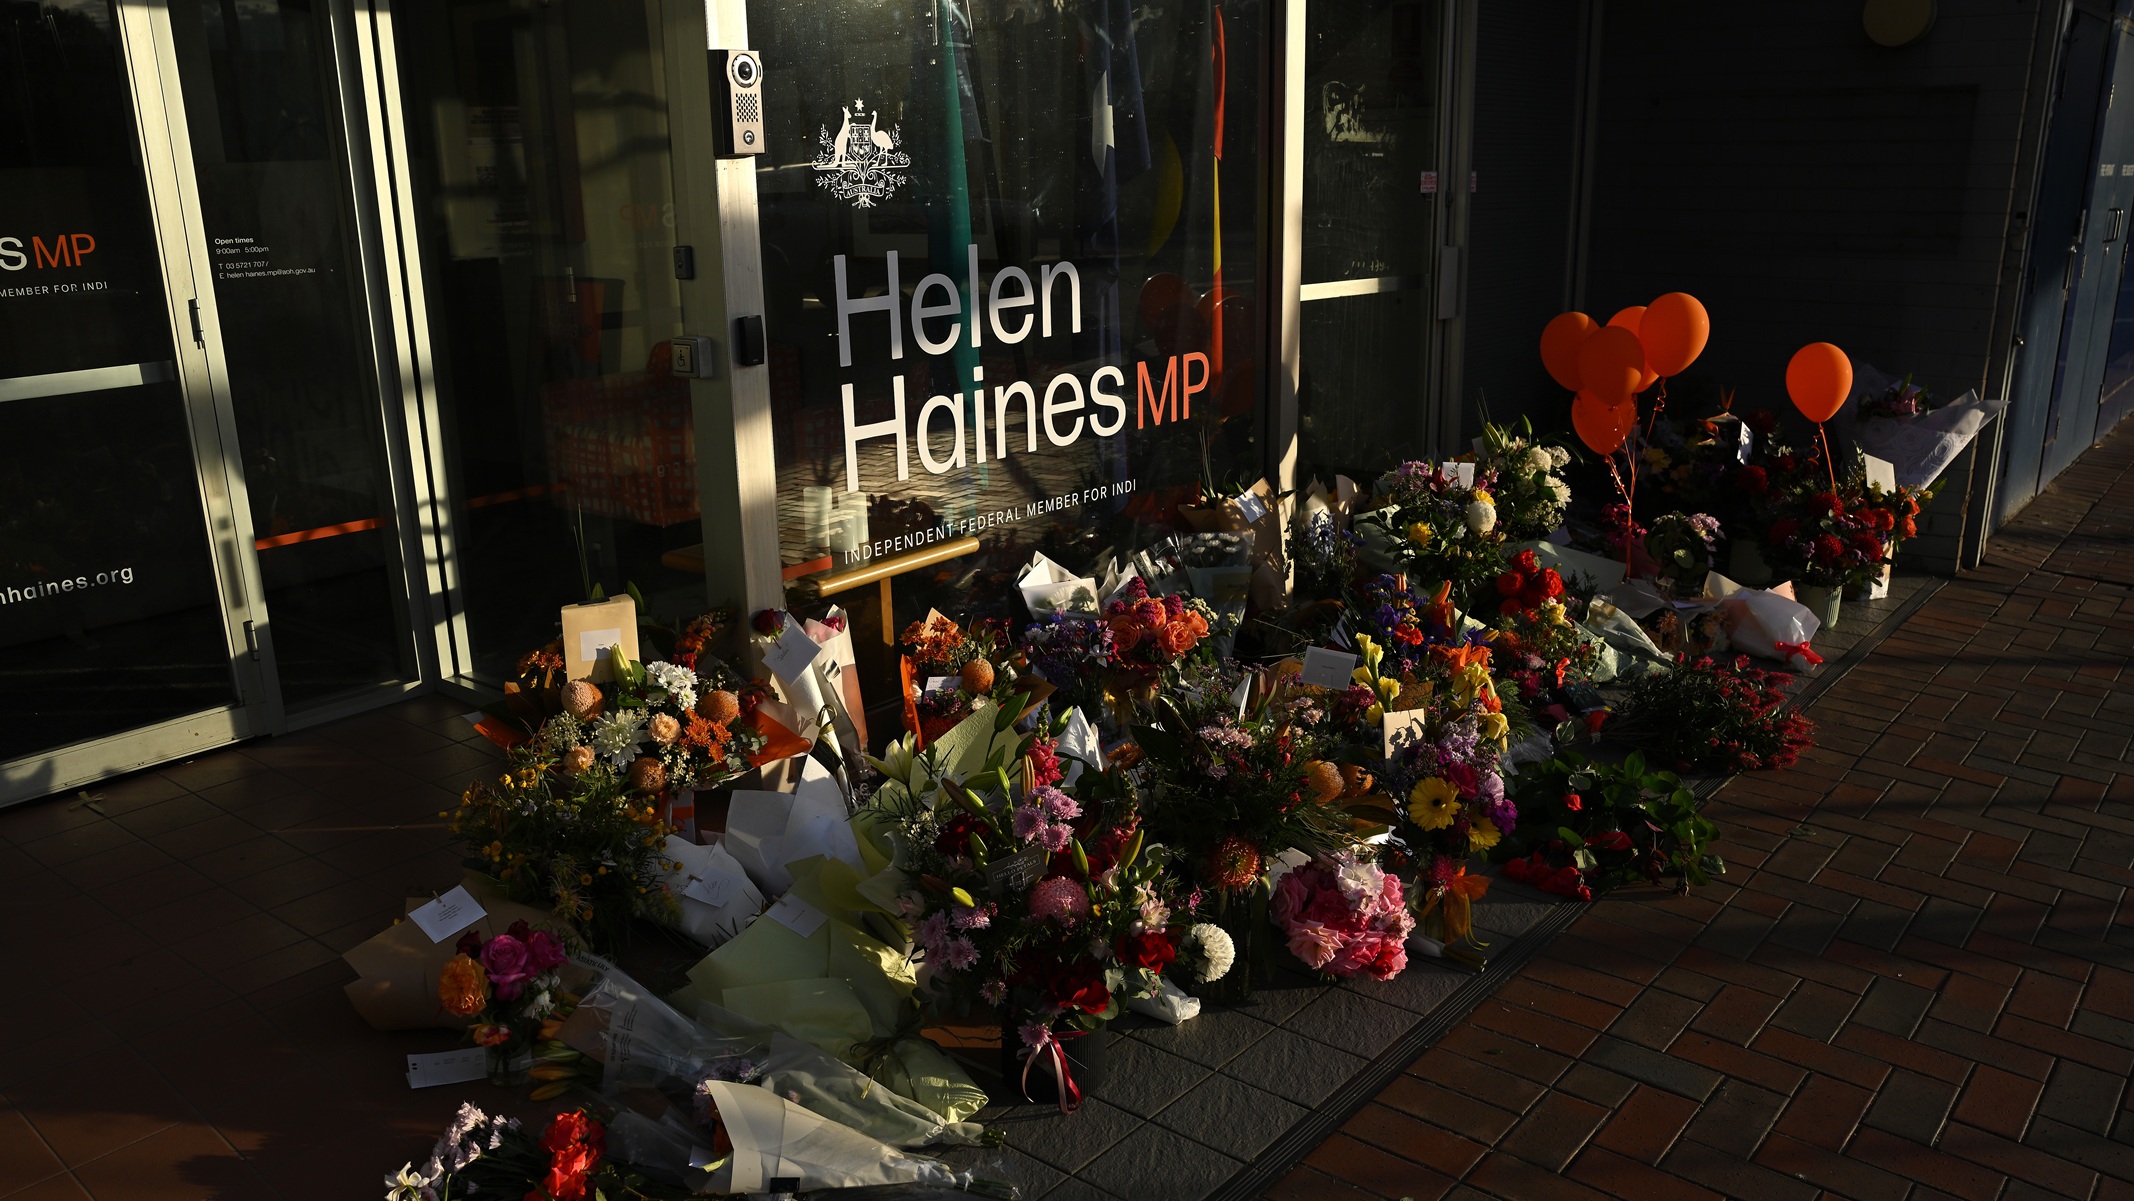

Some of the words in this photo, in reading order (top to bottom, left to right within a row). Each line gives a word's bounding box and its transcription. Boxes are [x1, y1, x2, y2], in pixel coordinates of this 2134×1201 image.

[846, 185, 881, 197] AUSTRALIA
[32, 233, 96, 269] MP
[0, 285, 49, 298] MEMBER
[53, 283, 78, 294] FOR
[82, 281, 108, 291] INDI
[833, 243, 1082, 367] Helen
[841, 364, 1127, 493] Haines
[1135, 350, 1211, 430] MP
[844, 522, 955, 565] INDEPENDENT
[960, 507, 1021, 535] FEDERAL
[1026, 492, 1079, 517] MEMBER
[1083, 486, 1107, 503] FOR
[1112, 478, 1136, 497] INDI
[995, 868, 1016, 879] HELLO
[1016, 859, 1037, 872] PETALS
[577, 955, 598, 969] ASIATIC
[597, 962, 611, 972] LILY
